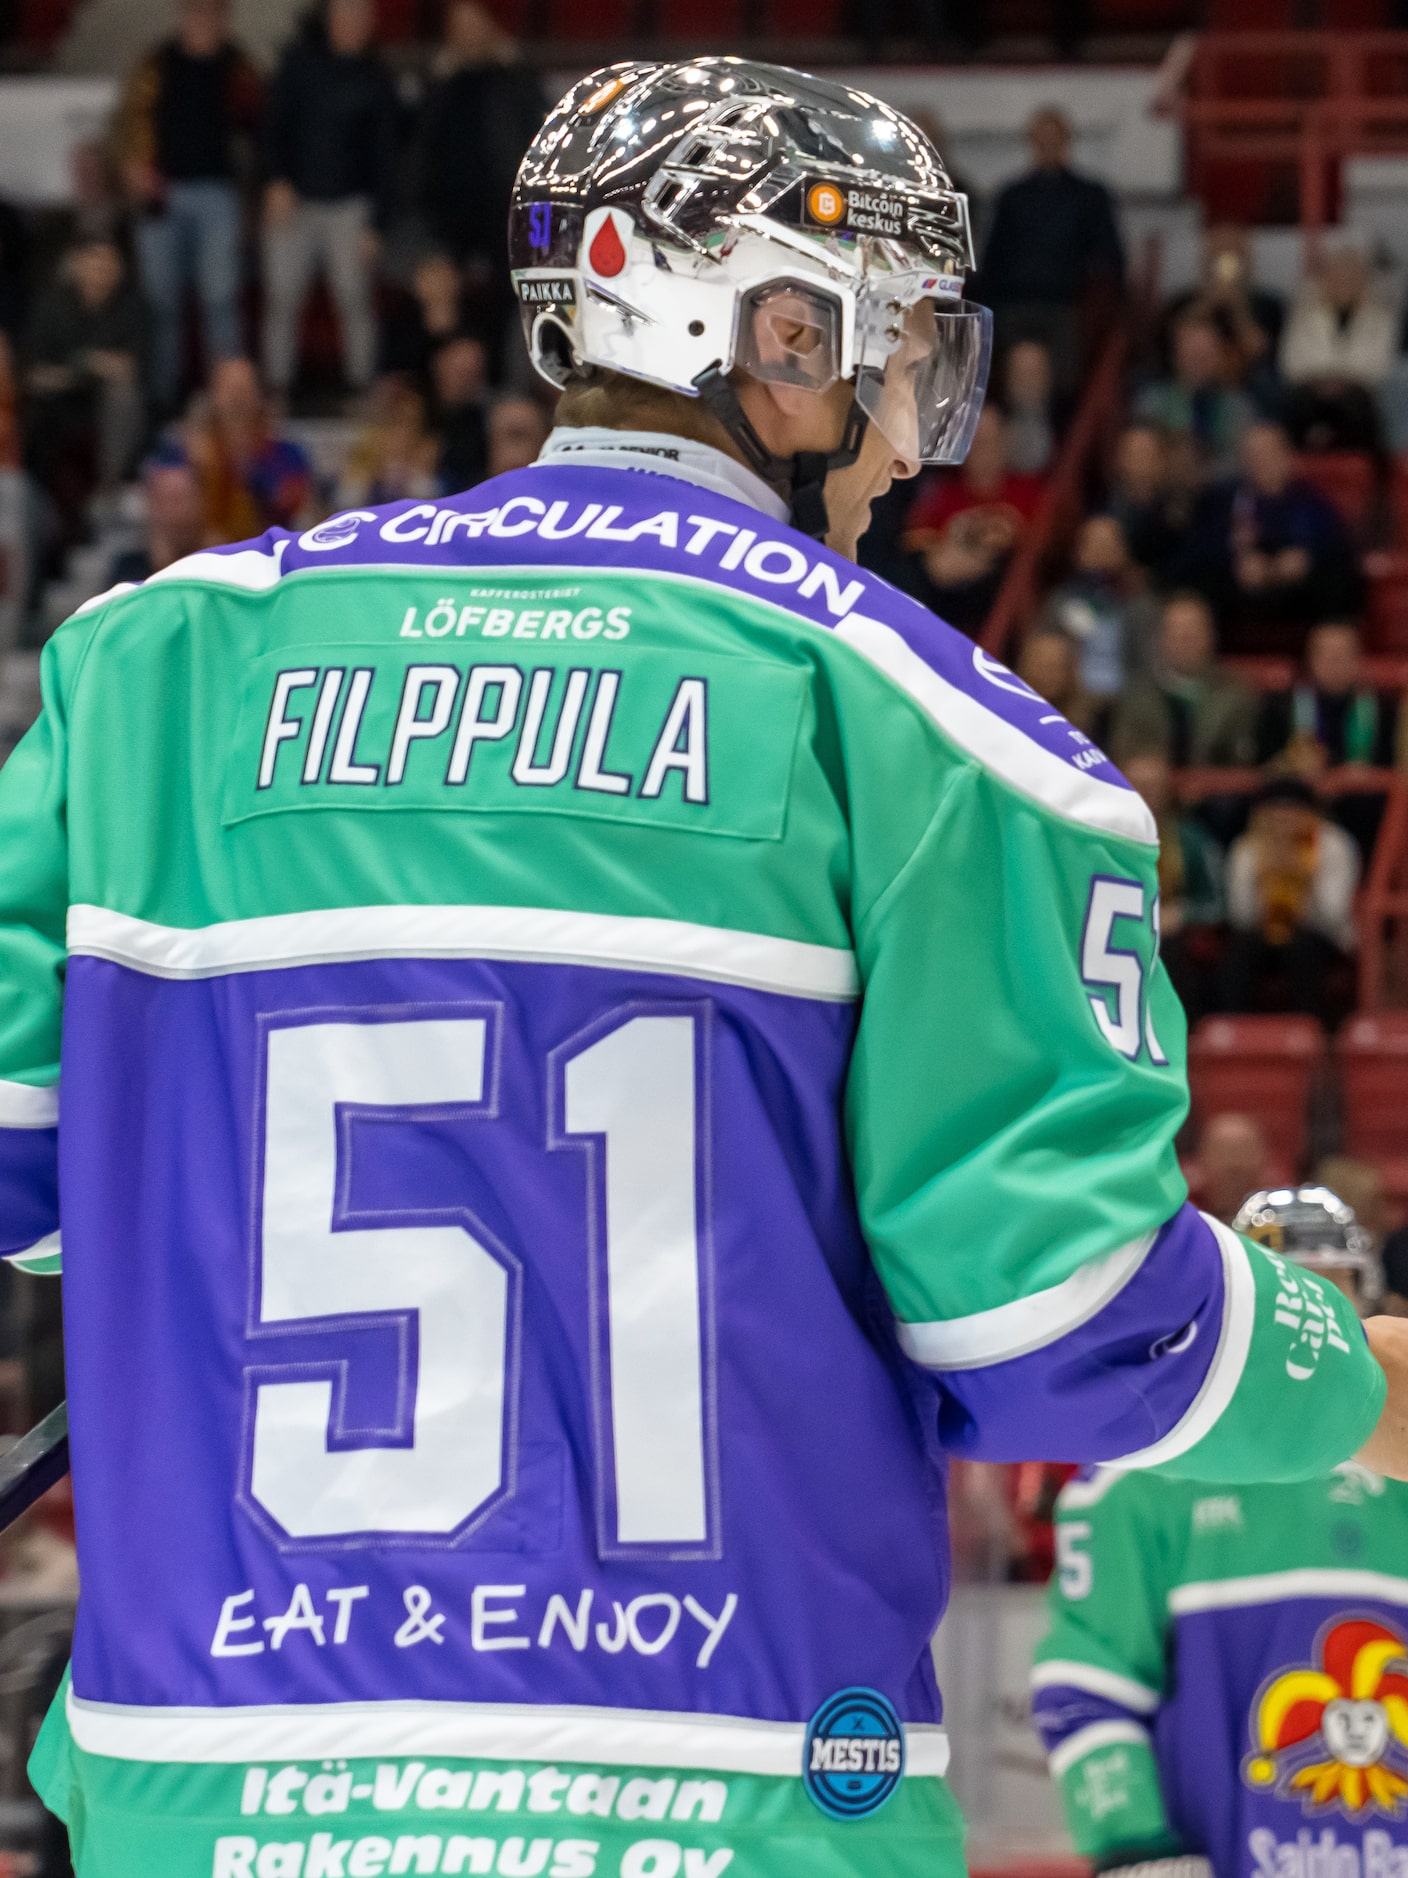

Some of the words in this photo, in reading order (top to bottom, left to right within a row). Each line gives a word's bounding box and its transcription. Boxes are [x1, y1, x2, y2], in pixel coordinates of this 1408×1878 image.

[847, 207, 902, 235] keskus
[848, 190, 904, 217] Bitcoin
[521, 281, 573, 301] PAIKKA
[379, 497, 866, 617] CIRCULATION
[399, 598, 632, 640] LÖFBERGS
[256, 663, 711, 806] FILPPULA
[238, 1000, 720, 1558] 51
[210, 1583, 369, 1657] EAT
[394, 1585, 447, 1647] &
[471, 1584, 738, 1669] ENJOY
[809, 1737, 900, 1772] MESTIS
[240, 1758, 729, 1822] Itä-Vantaan
[212, 1832, 600, 1878] Rakennus
